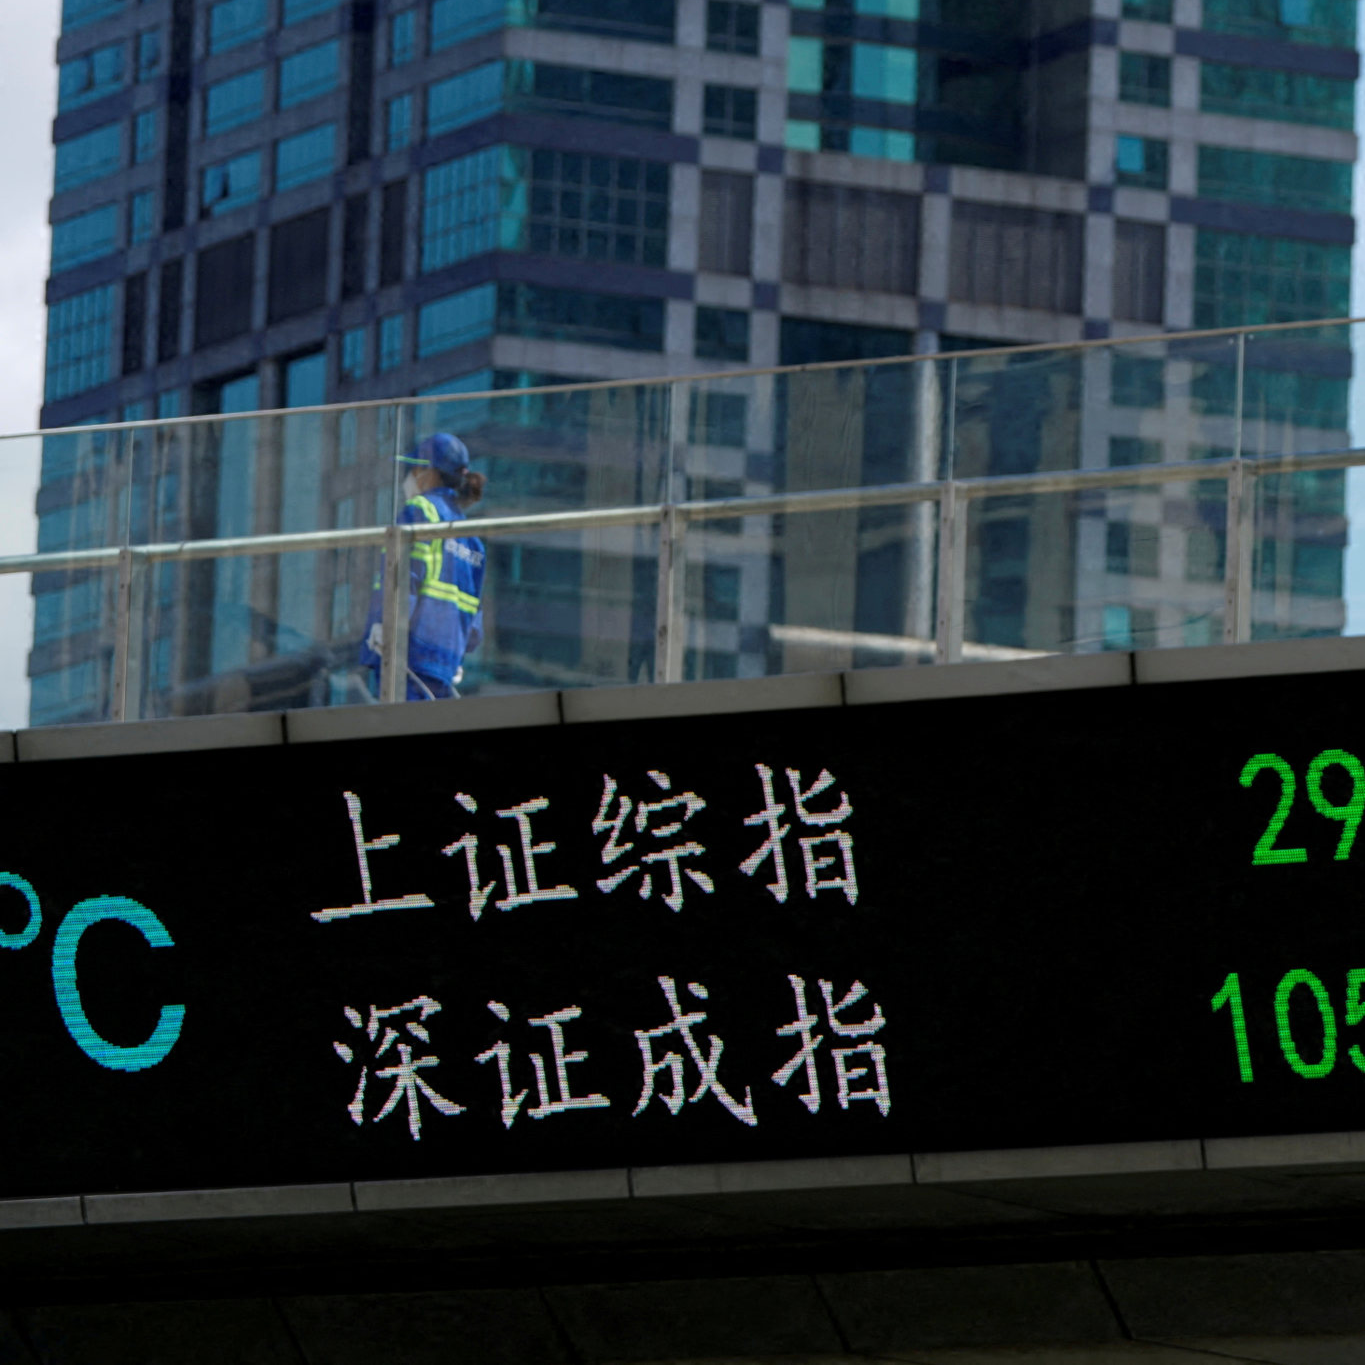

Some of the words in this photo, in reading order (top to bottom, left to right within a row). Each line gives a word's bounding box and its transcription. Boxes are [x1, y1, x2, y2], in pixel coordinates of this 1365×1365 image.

[311, 763, 860, 922] 上证综指
[334, 973, 892, 1140] 深证成指
